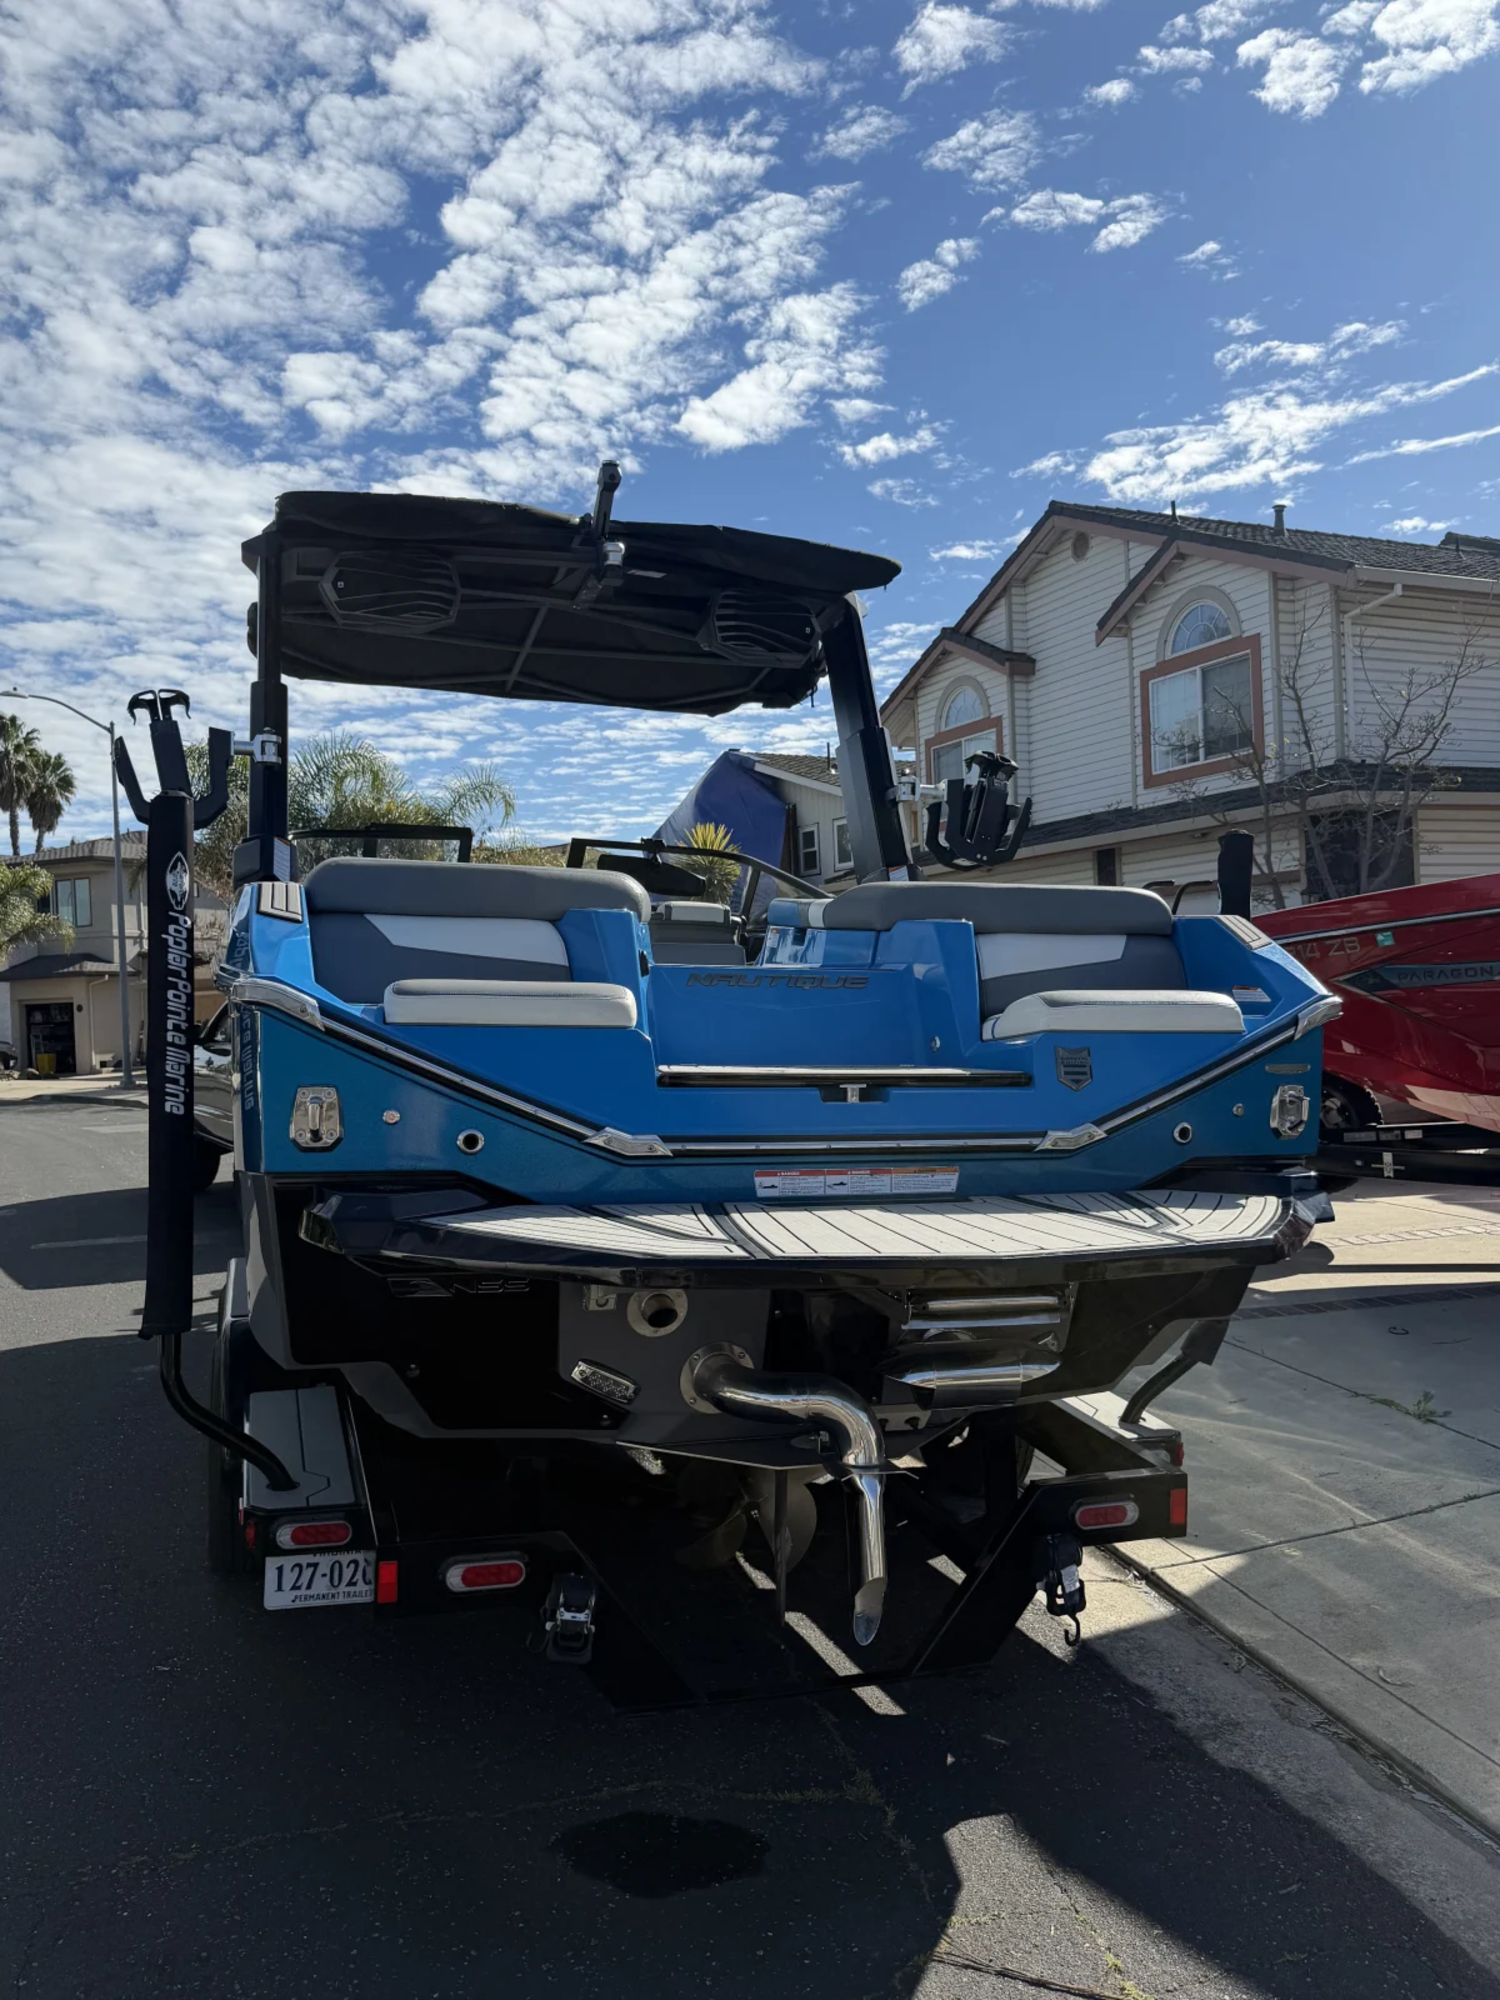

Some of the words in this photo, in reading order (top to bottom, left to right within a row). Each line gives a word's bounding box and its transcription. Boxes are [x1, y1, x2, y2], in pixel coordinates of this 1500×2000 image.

[162, 911, 192, 977] Poplar
[1324, 936, 1361, 956] ZB
[687, 974, 868, 989] NAUTIQUE
[1397, 965, 1494, 984] PARAGON
[167, 977, 190, 1044] Pointe
[164, 1047, 190, 1115] Marine
[294, 1592, 340, 1603] PERMANENT
